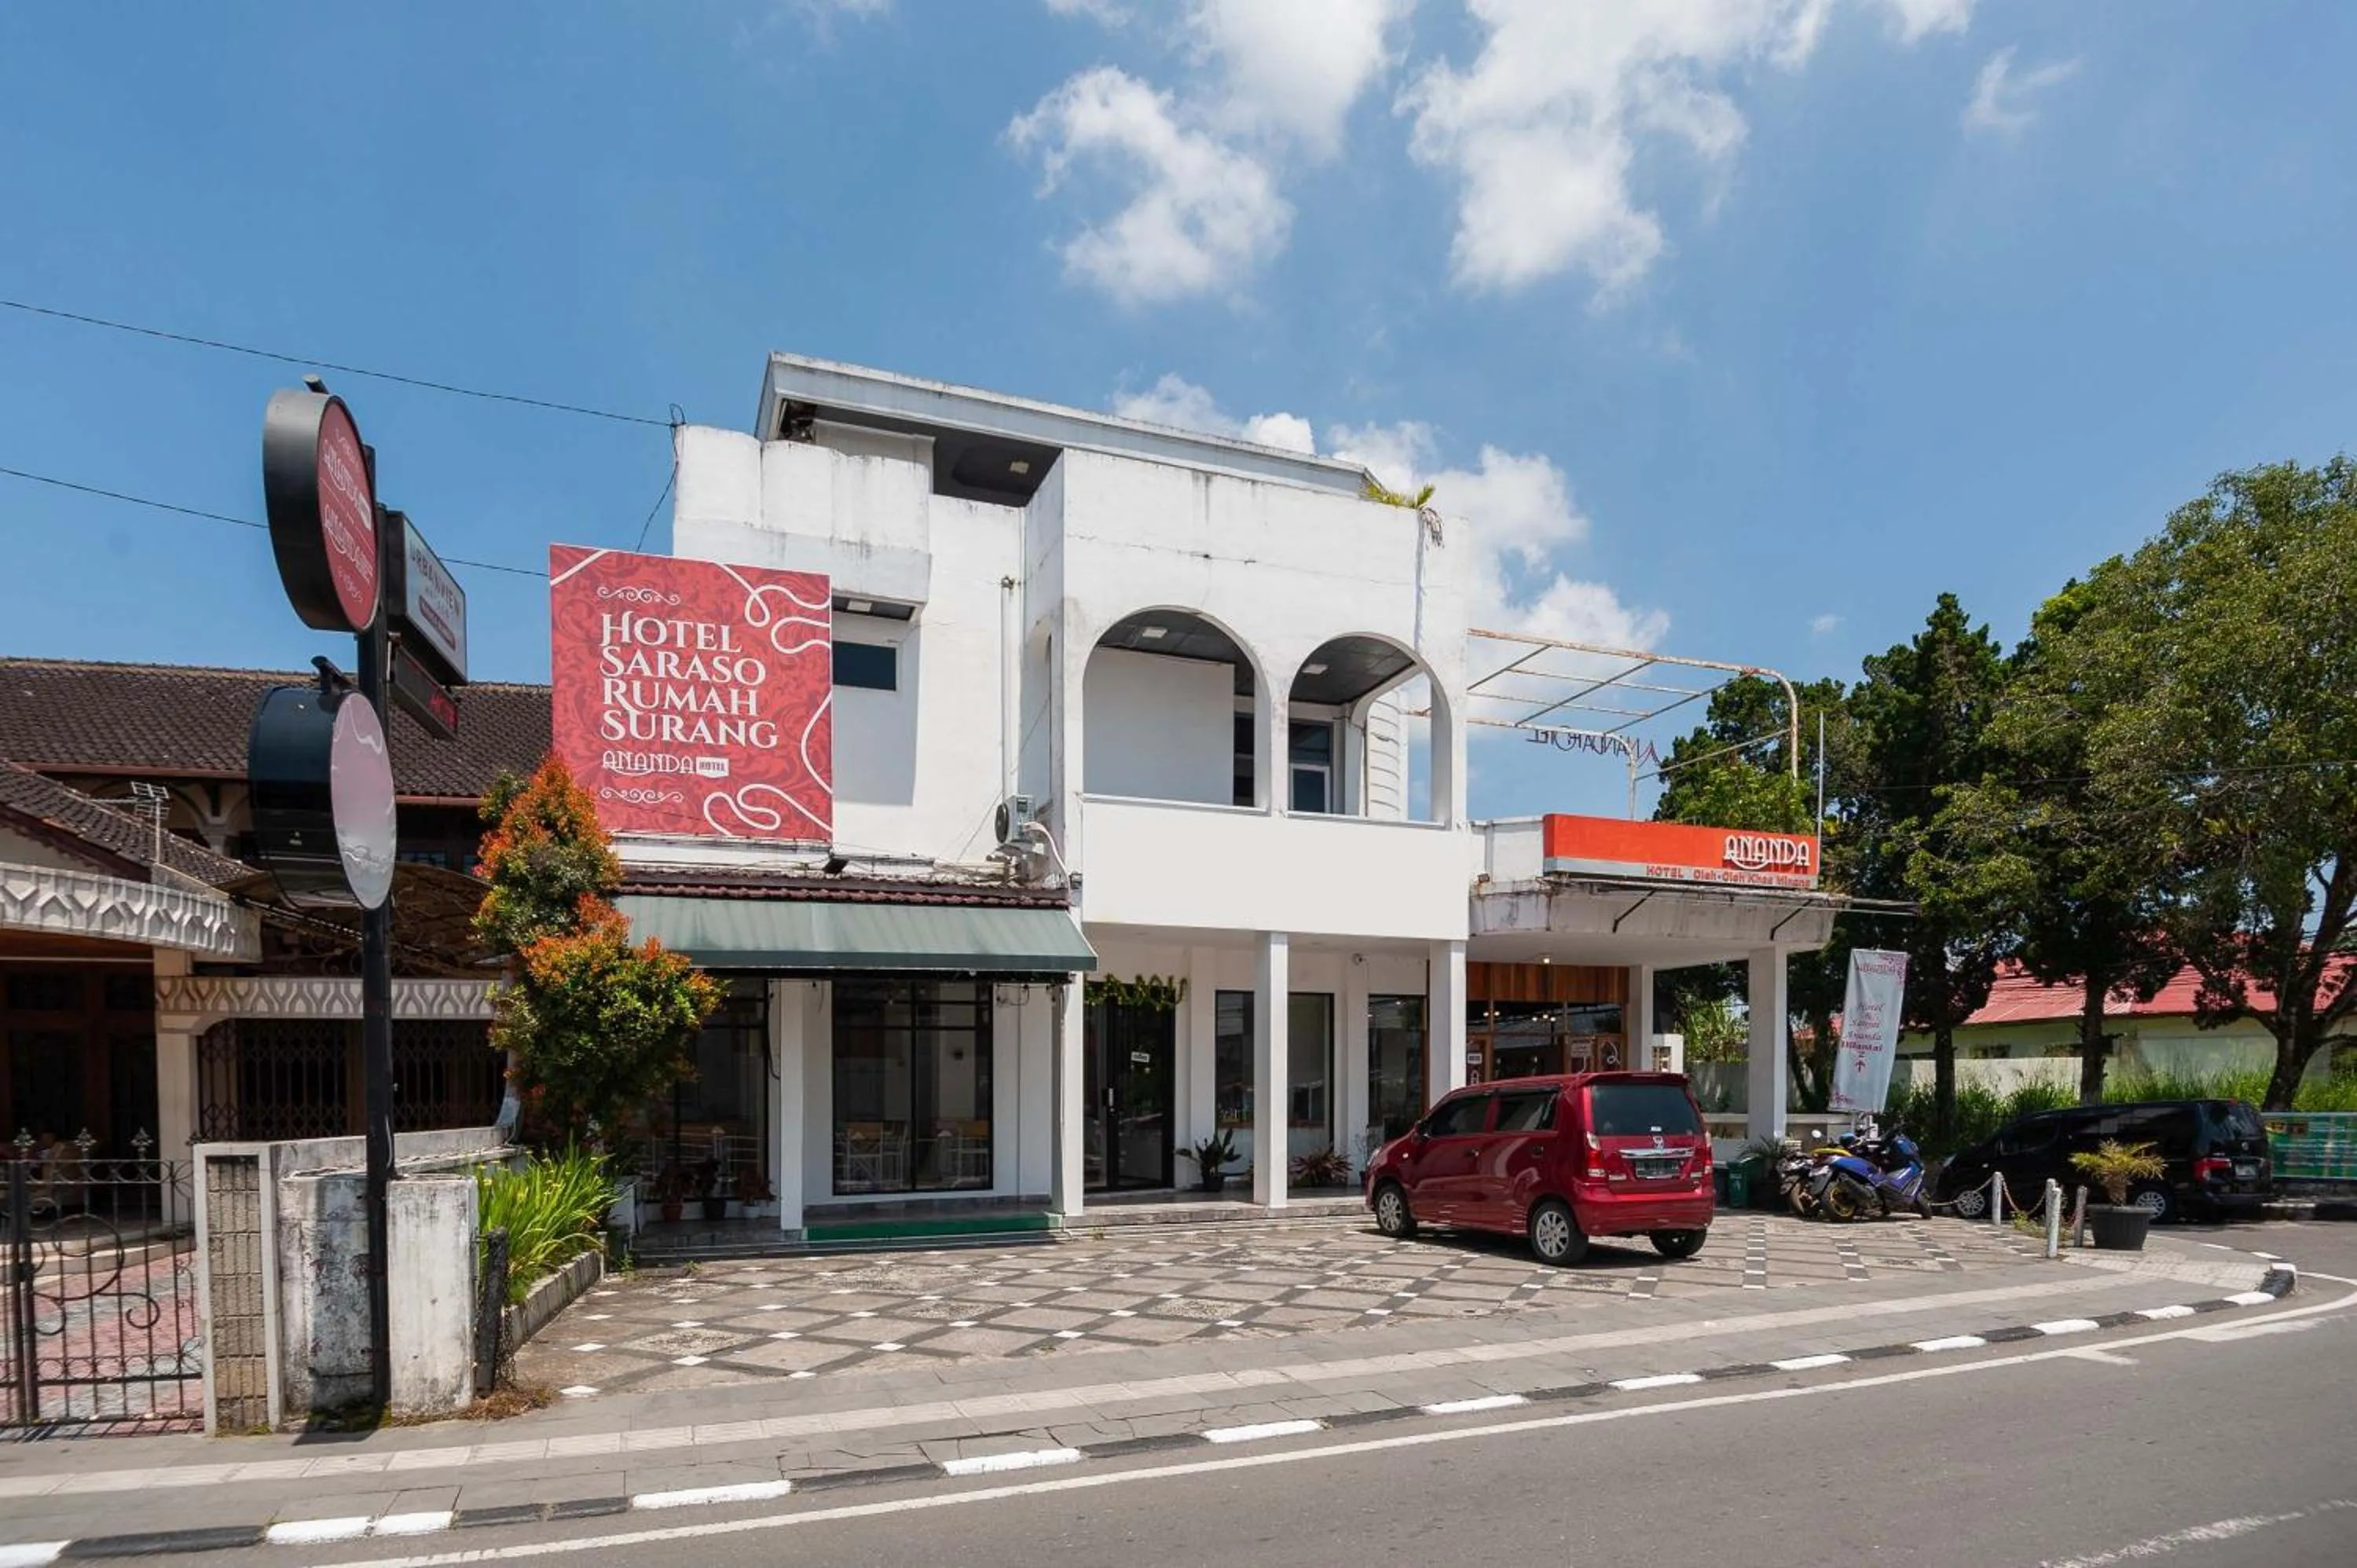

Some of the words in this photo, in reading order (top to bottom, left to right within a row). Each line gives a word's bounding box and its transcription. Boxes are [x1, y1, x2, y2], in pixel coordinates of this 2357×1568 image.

[599, 611, 741, 653] HOTEL
[599, 646, 765, 686] SARASO
[603, 678, 758, 716] RUMAH
[600, 710, 779, 749] SURANG
[602, 750, 696, 776] ANANDA
[1723, 834, 1810, 870] ANANDA
[1647, 866, 1684, 878] HOTEL
[1748, 874, 1772, 885] Khas
